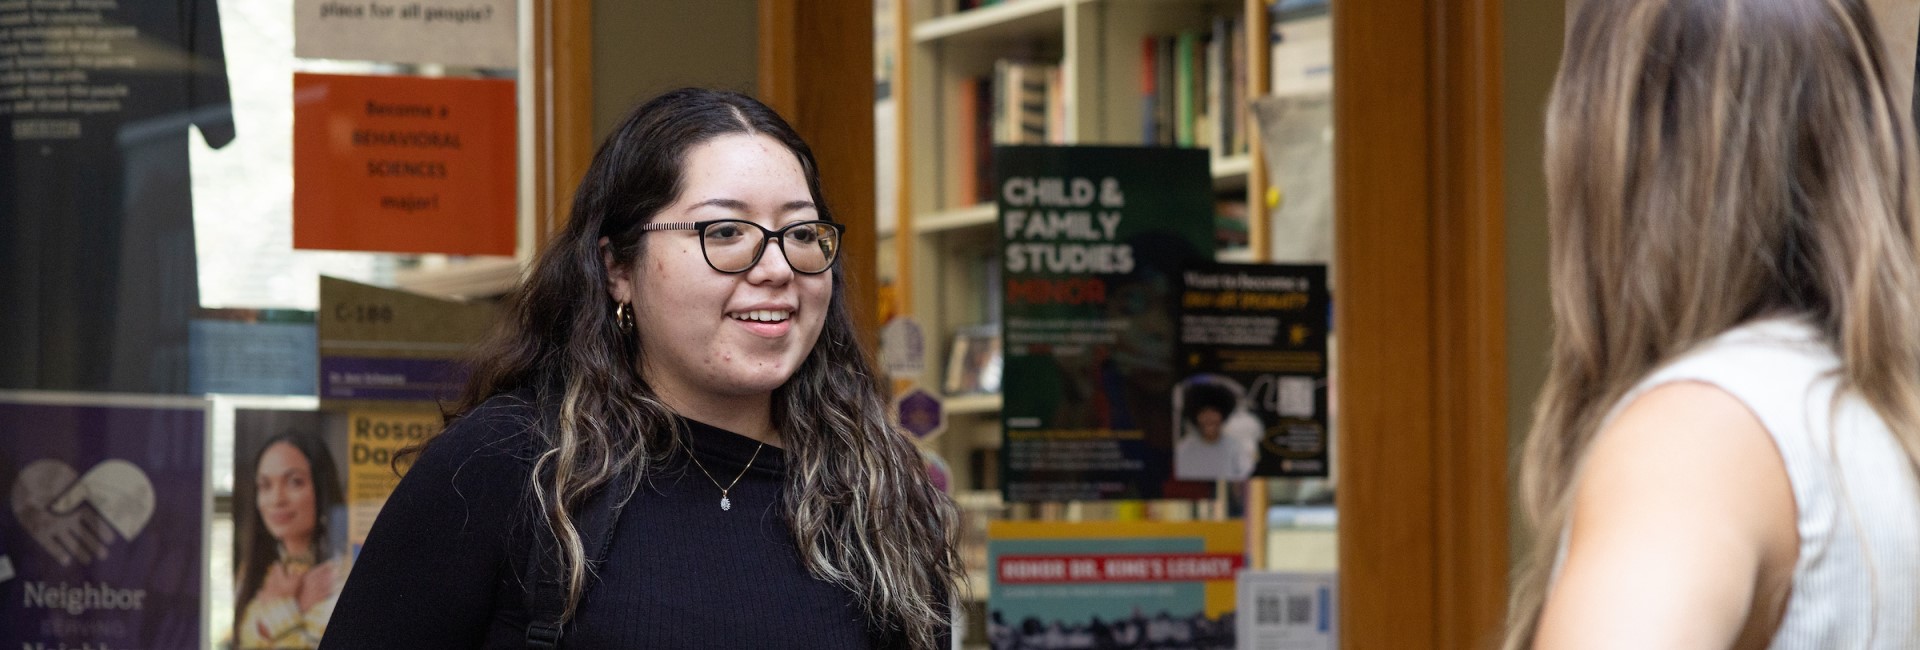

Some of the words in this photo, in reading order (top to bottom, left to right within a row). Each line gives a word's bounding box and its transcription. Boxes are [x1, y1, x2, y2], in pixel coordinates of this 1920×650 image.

[320, 3, 363, 20] place
[370, 3, 393, 17] for
[399, 3, 420, 17] all
[424, 5, 494, 22] people?
[365, 101, 433, 117] Become
[440, 107, 449, 118] a
[352, 130, 461, 150] BEHAVIORAL
[367, 161, 447, 179] SCIENCES
[1003, 177, 1094, 206] CHILD
[1099, 177, 1124, 206] &
[381, 195, 439, 212] major!
[1004, 211, 1121, 240] FAMILY
[1006, 244, 1135, 273] STUDIES
[1007, 278, 1107, 305] MINOR
[1002, 558, 1066, 579] HONOR
[1070, 558, 1102, 579] DR.
[1105, 557, 1163, 578] KING'S
[23, 581, 146, 615] Neighbor
